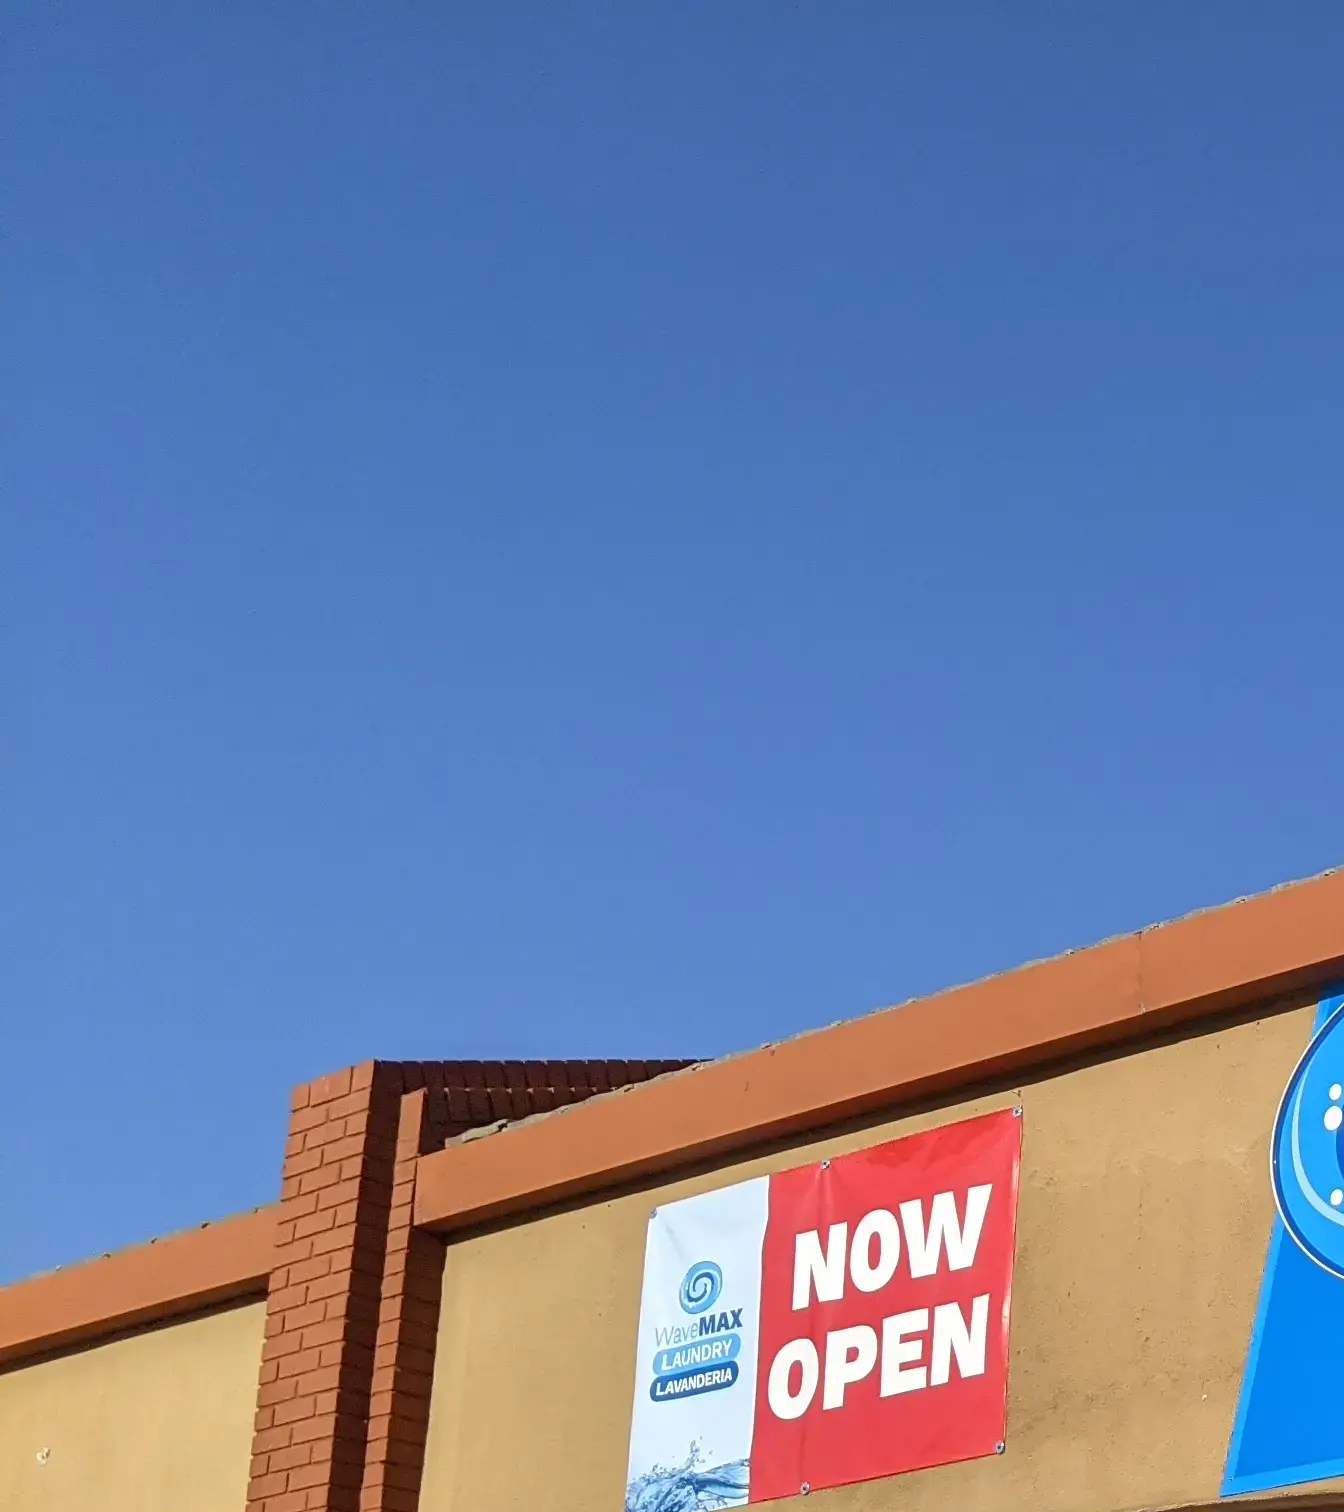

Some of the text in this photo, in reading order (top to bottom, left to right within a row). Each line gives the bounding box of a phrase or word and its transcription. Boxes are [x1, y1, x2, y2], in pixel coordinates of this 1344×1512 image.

[792, 1183, 992, 1311] NOW
[655, 1308, 743, 1347] WaveMAX
[661, 1339, 732, 1371] LAUNDRY
[767, 1293, 990, 1420] OPEN
[655, 1367, 733, 1396] LAVANDERIA
